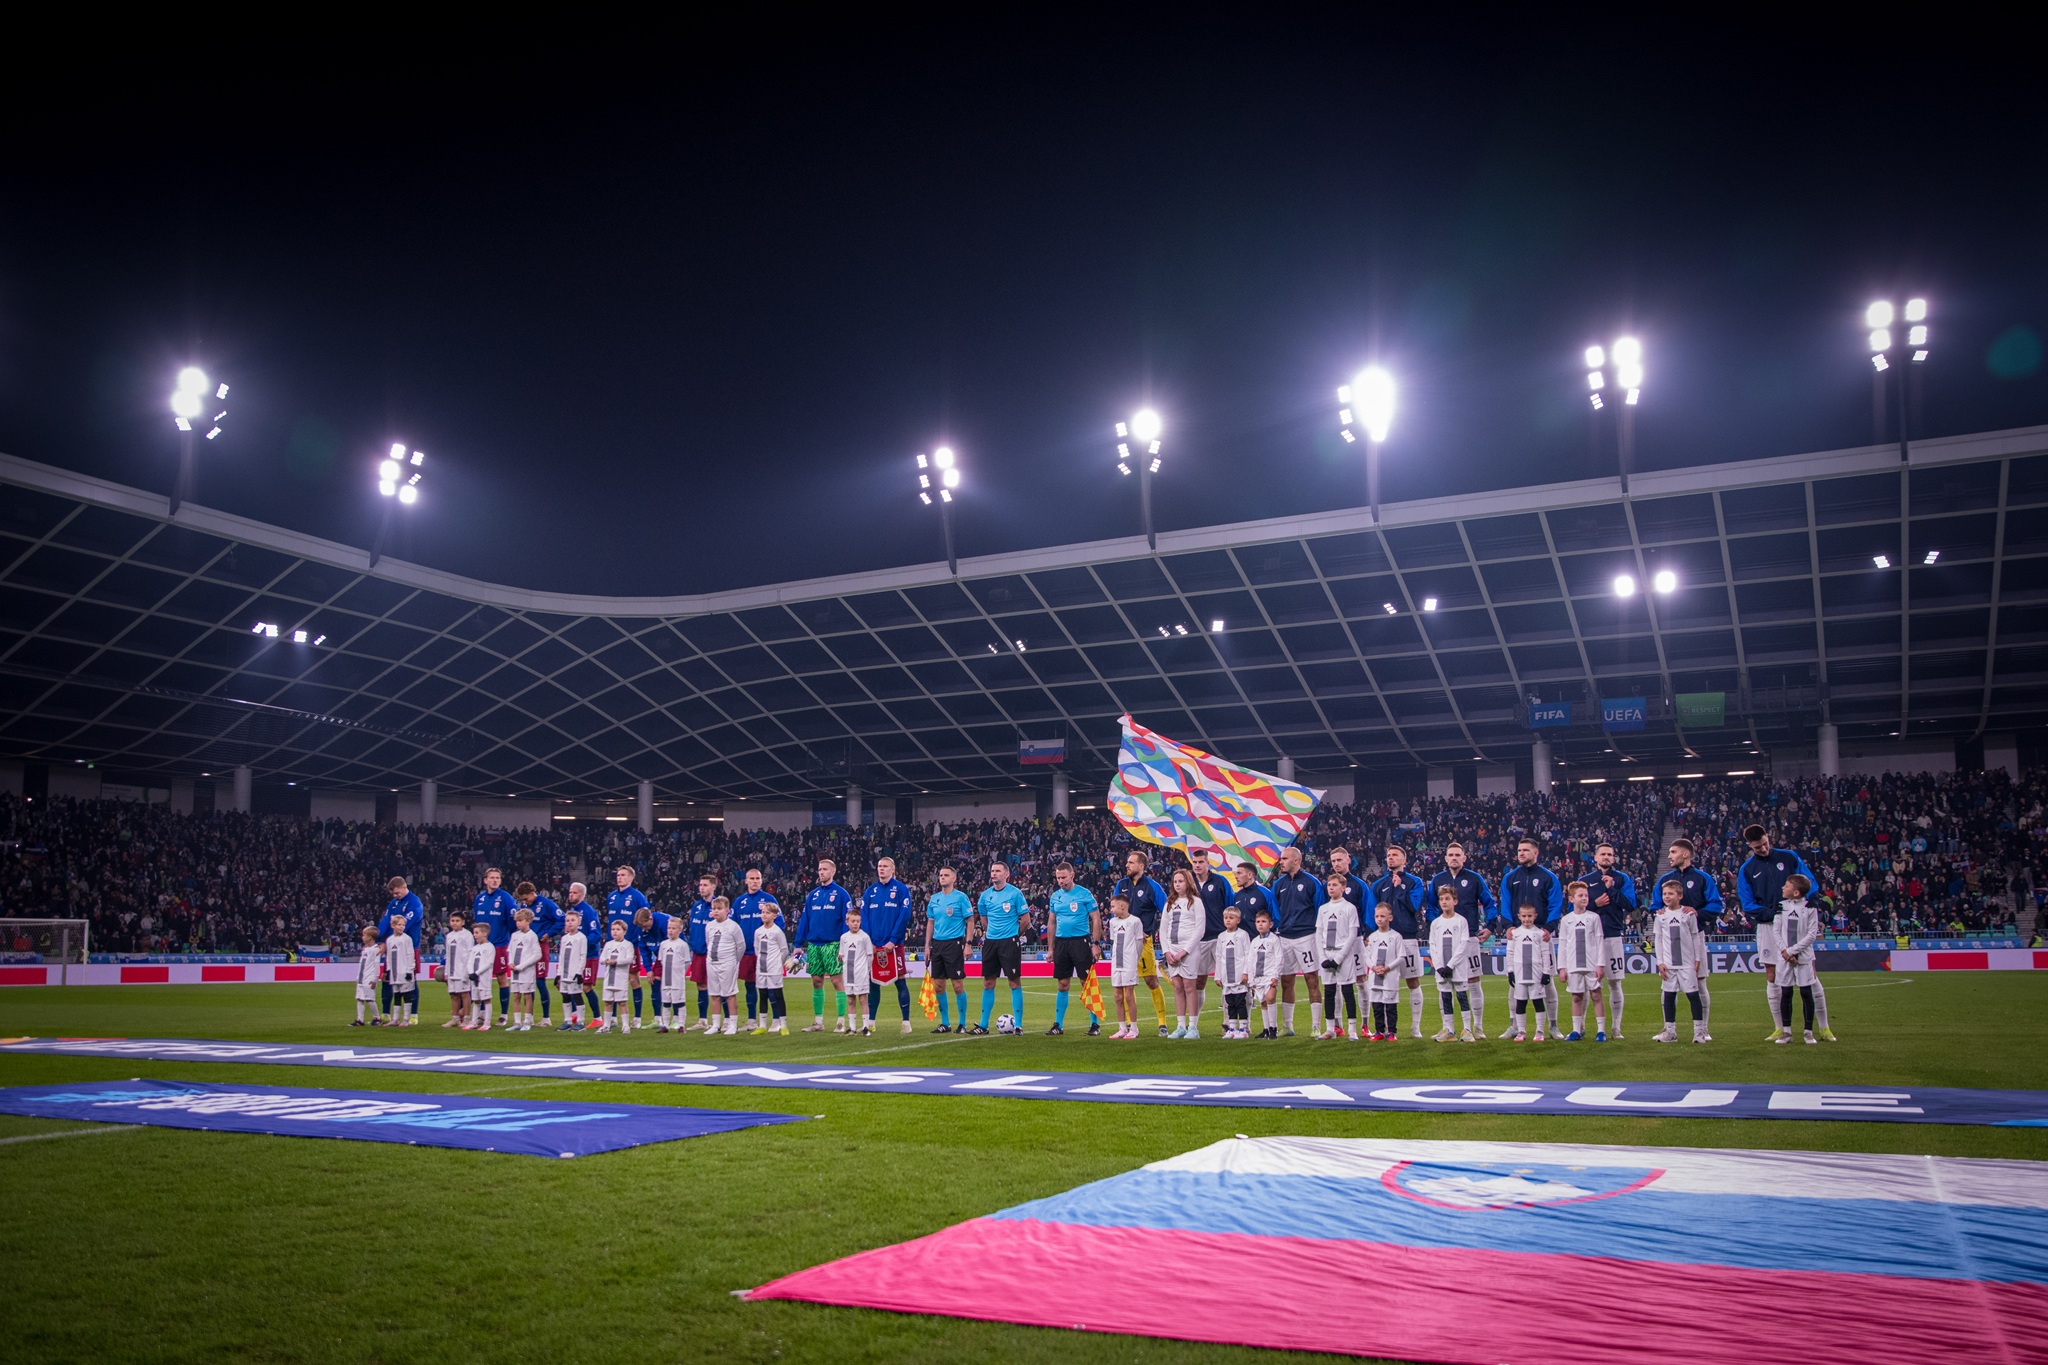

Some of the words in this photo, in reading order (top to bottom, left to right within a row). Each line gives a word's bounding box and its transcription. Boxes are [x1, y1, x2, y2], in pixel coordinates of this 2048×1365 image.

[1534, 709, 1565, 720] FIFA
[1603, 709, 1642, 722] UEFA
[1691, 706, 1721, 714] RESPECT
[1302, 950, 1314, 963] 21
[1404, 954, 1415, 968] 17
[1467, 955, 1481, 969] 10
[1142, 958, 1147, 969] 1
[1610, 957, 1623, 970] 20
[256, 1049, 955, 1085] NATIONS
[950, 1075, 1925, 1114] LEAGUE
